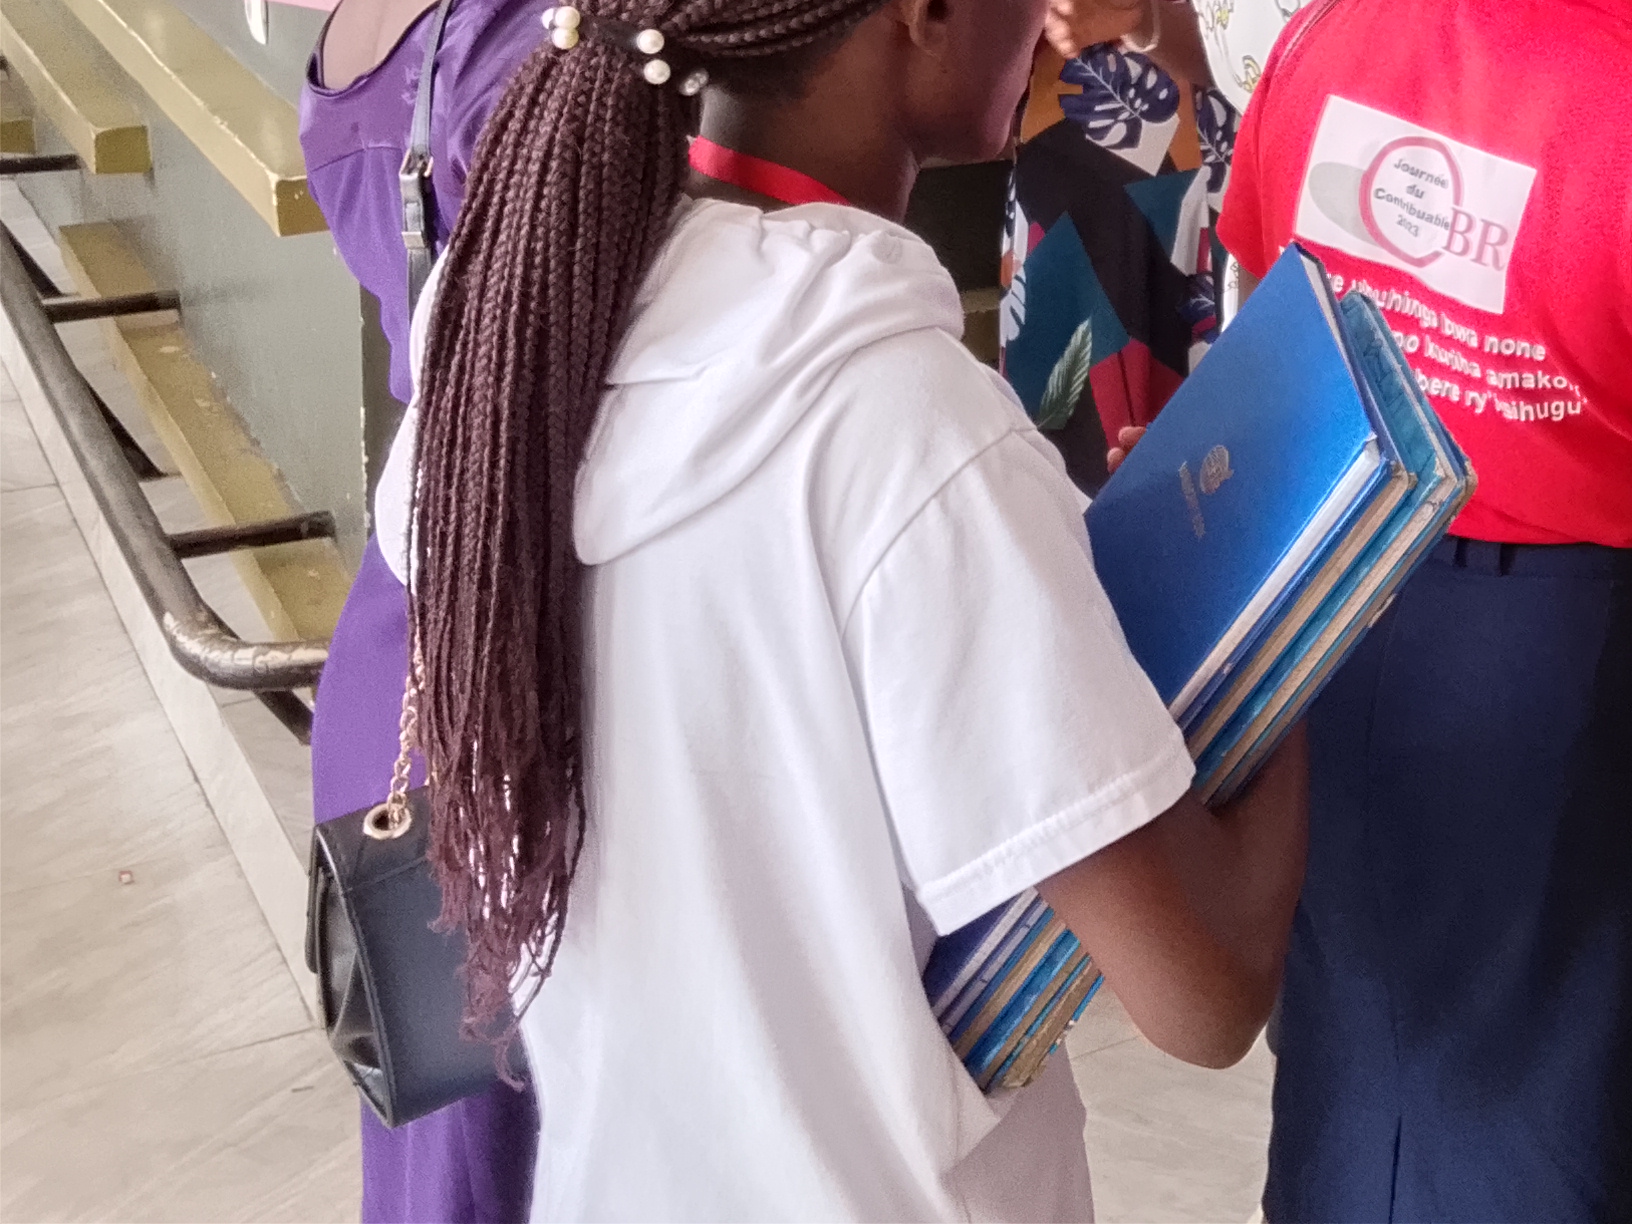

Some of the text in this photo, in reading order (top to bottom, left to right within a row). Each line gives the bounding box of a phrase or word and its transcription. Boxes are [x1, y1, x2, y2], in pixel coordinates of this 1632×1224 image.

[1405, 184, 1425, 199] du
[1374, 187, 1451, 231] Contribuable
[1485, 335, 1546, 361] none
